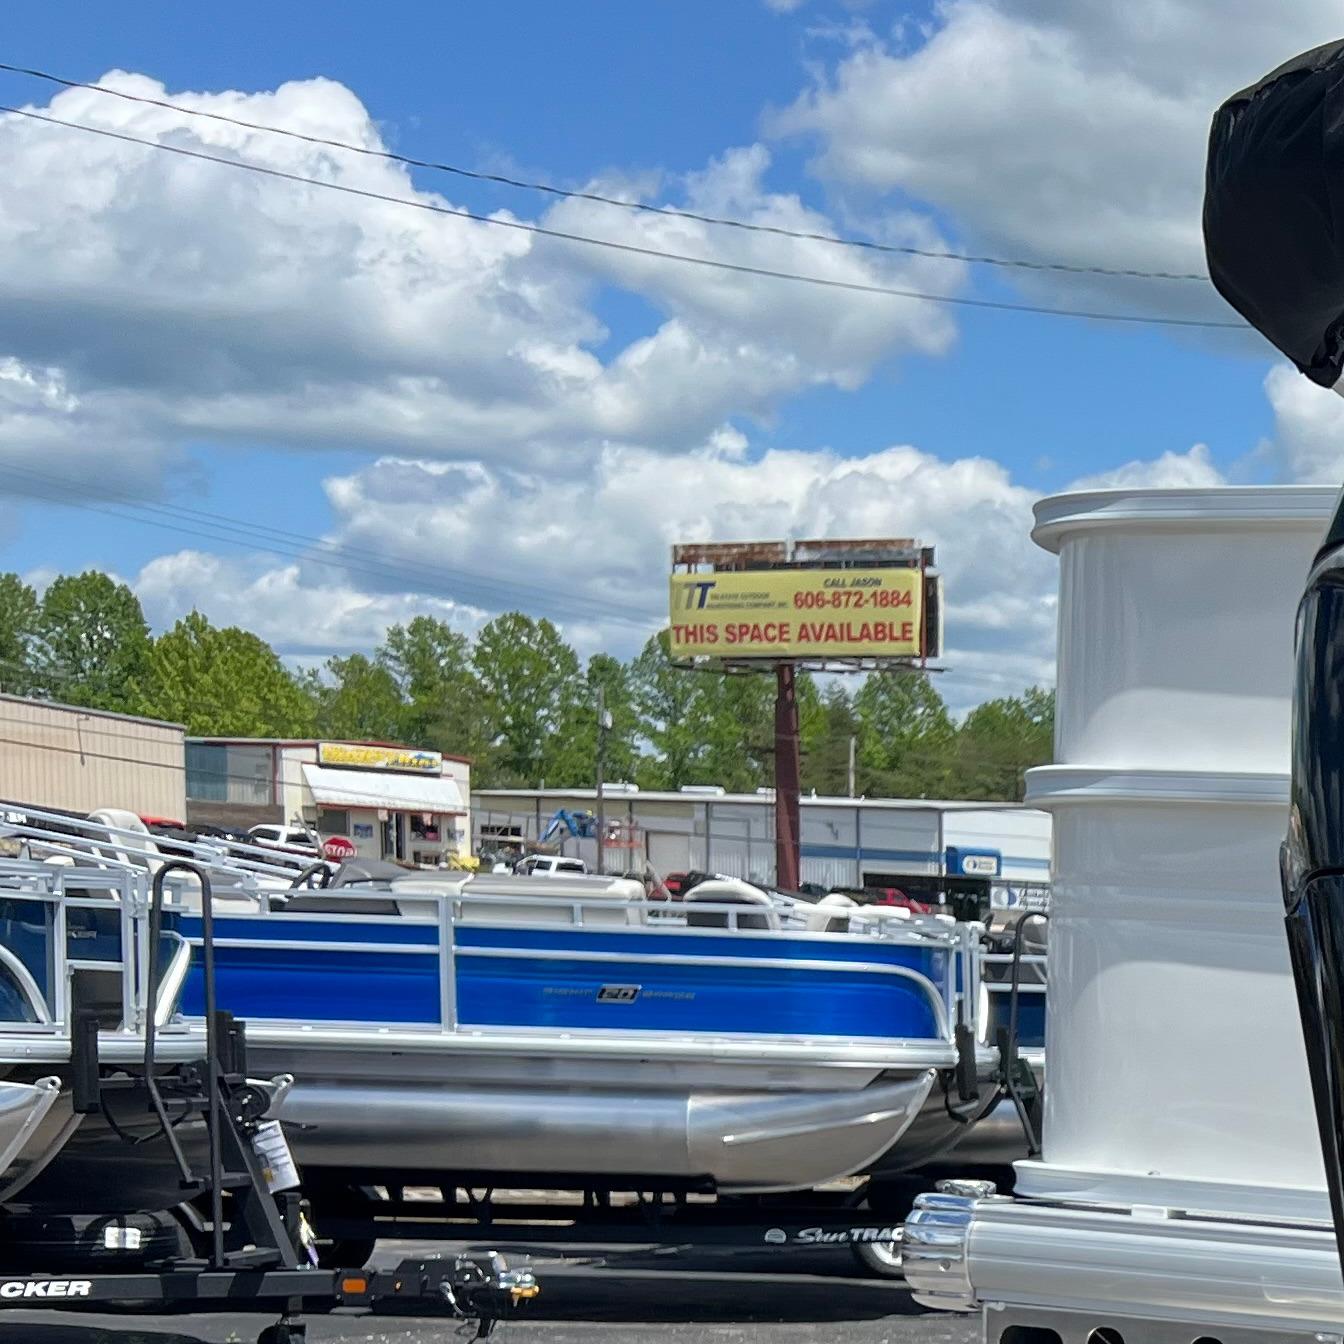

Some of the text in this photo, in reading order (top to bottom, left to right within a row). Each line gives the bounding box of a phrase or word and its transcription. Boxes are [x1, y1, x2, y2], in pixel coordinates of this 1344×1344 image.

[823, 577, 883, 588] CALL JASON
[793, 590, 912, 610] 606-872-1884
[673, 621, 913, 644] THIS SPACE AVAILABLE
[792, 1227, 848, 1244] Sun
[0, 1280, 92, 1298] CKER
